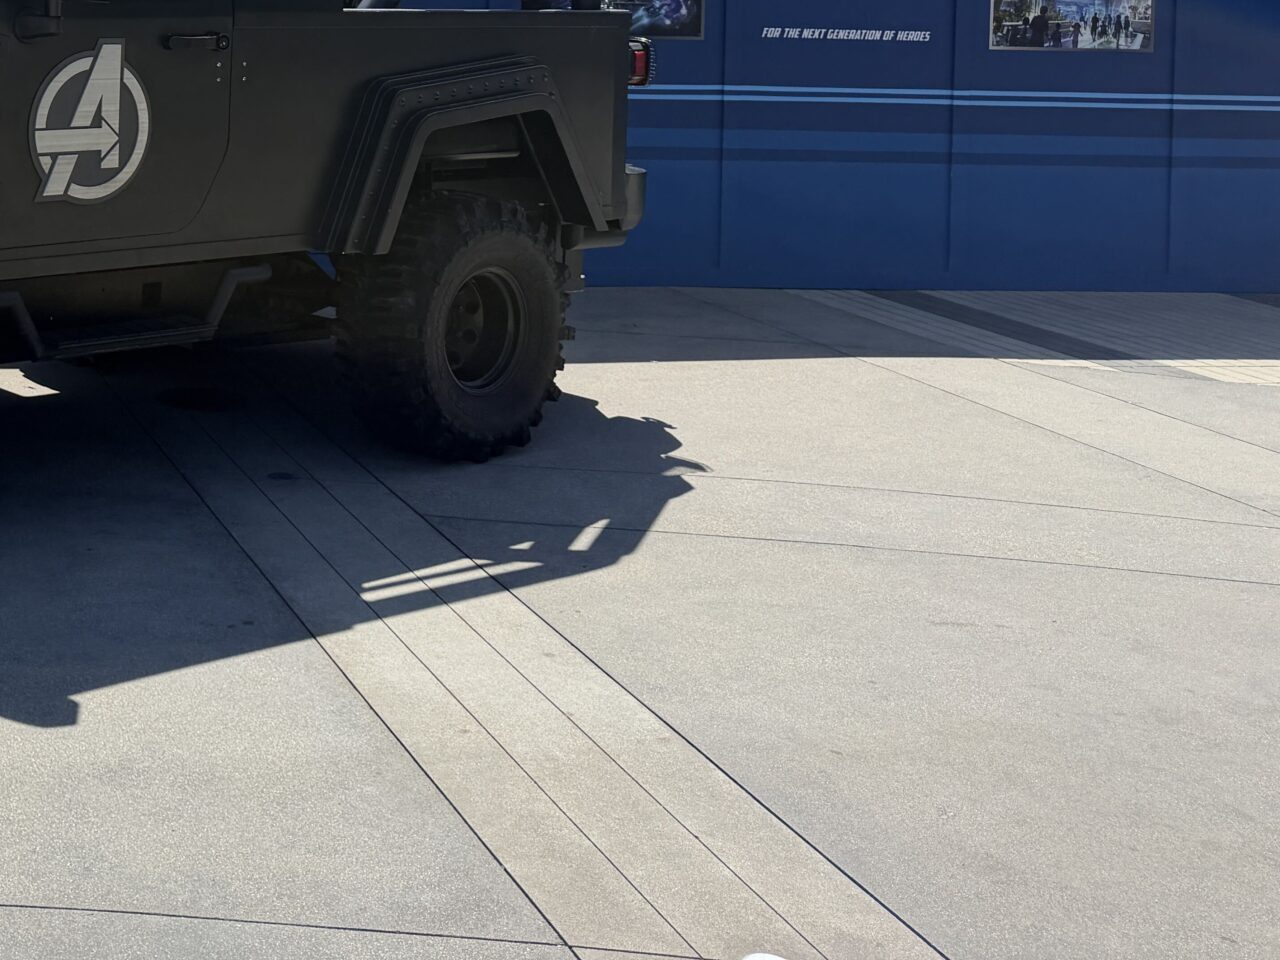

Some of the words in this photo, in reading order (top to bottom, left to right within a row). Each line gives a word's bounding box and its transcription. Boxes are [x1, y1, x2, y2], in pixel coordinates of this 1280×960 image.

[762, 27, 781, 38] FOR
[783, 28, 801, 39] THE
[801, 28, 826, 39] NEXT
[826, 29, 882, 41] GENERATION
[882, 30, 896, 41] OF
[896, 31, 931, 42] HEROES
